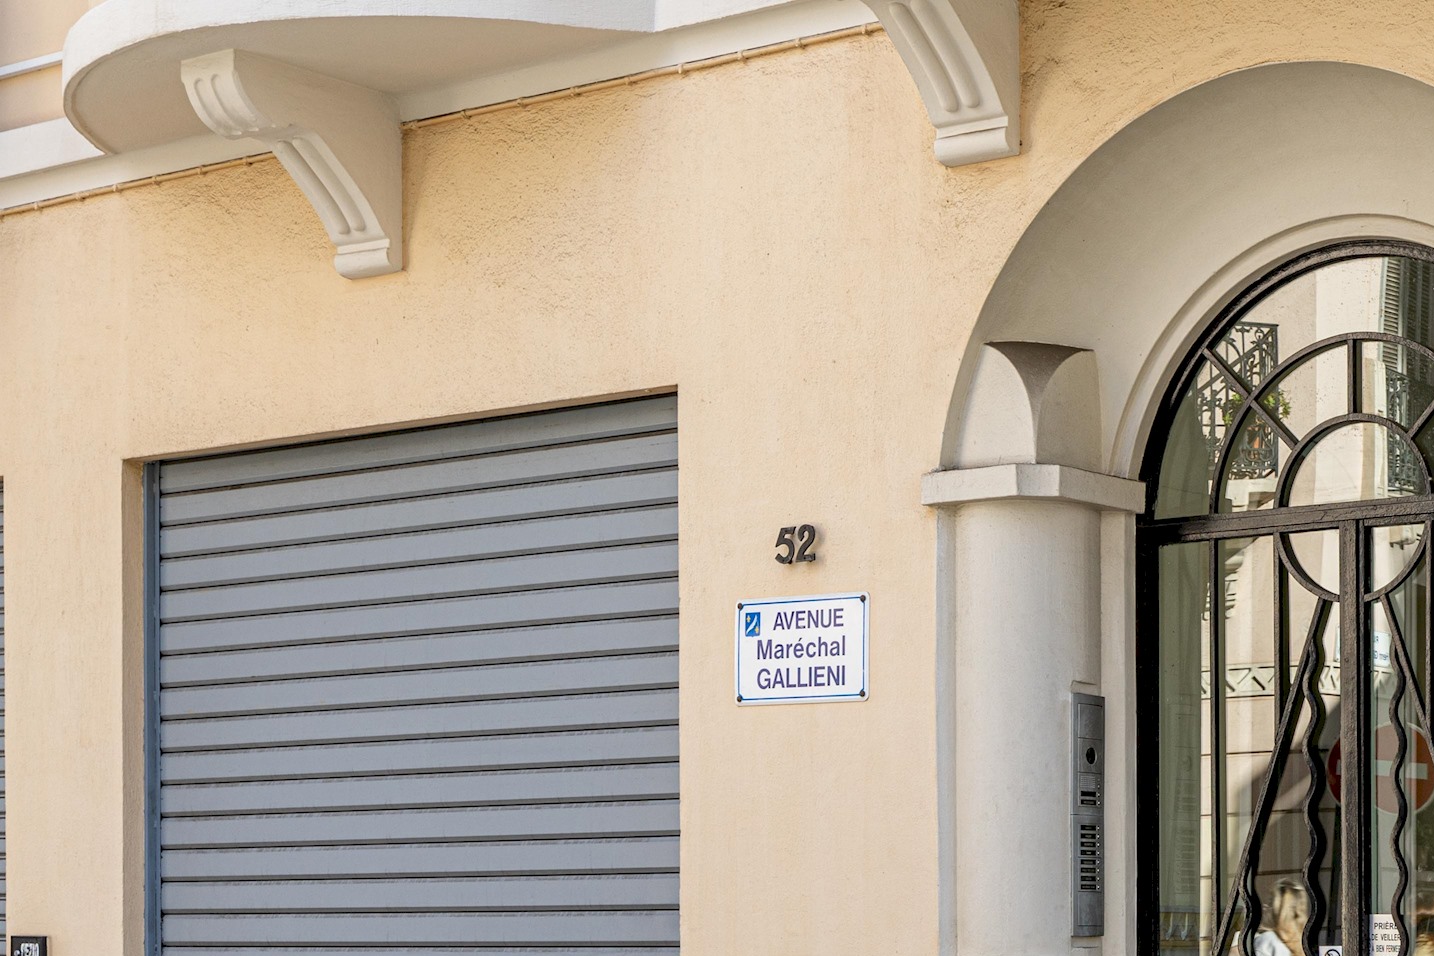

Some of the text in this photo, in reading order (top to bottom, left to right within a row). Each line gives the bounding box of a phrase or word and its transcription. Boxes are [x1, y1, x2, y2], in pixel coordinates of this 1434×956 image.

[774, 524, 816, 565] 52
[772, 608, 844, 631] AVENUE
[757, 635, 846, 660] Maréchal
[757, 665, 846, 690] GALLIENI
[1371, 933, 1378, 941] DE
